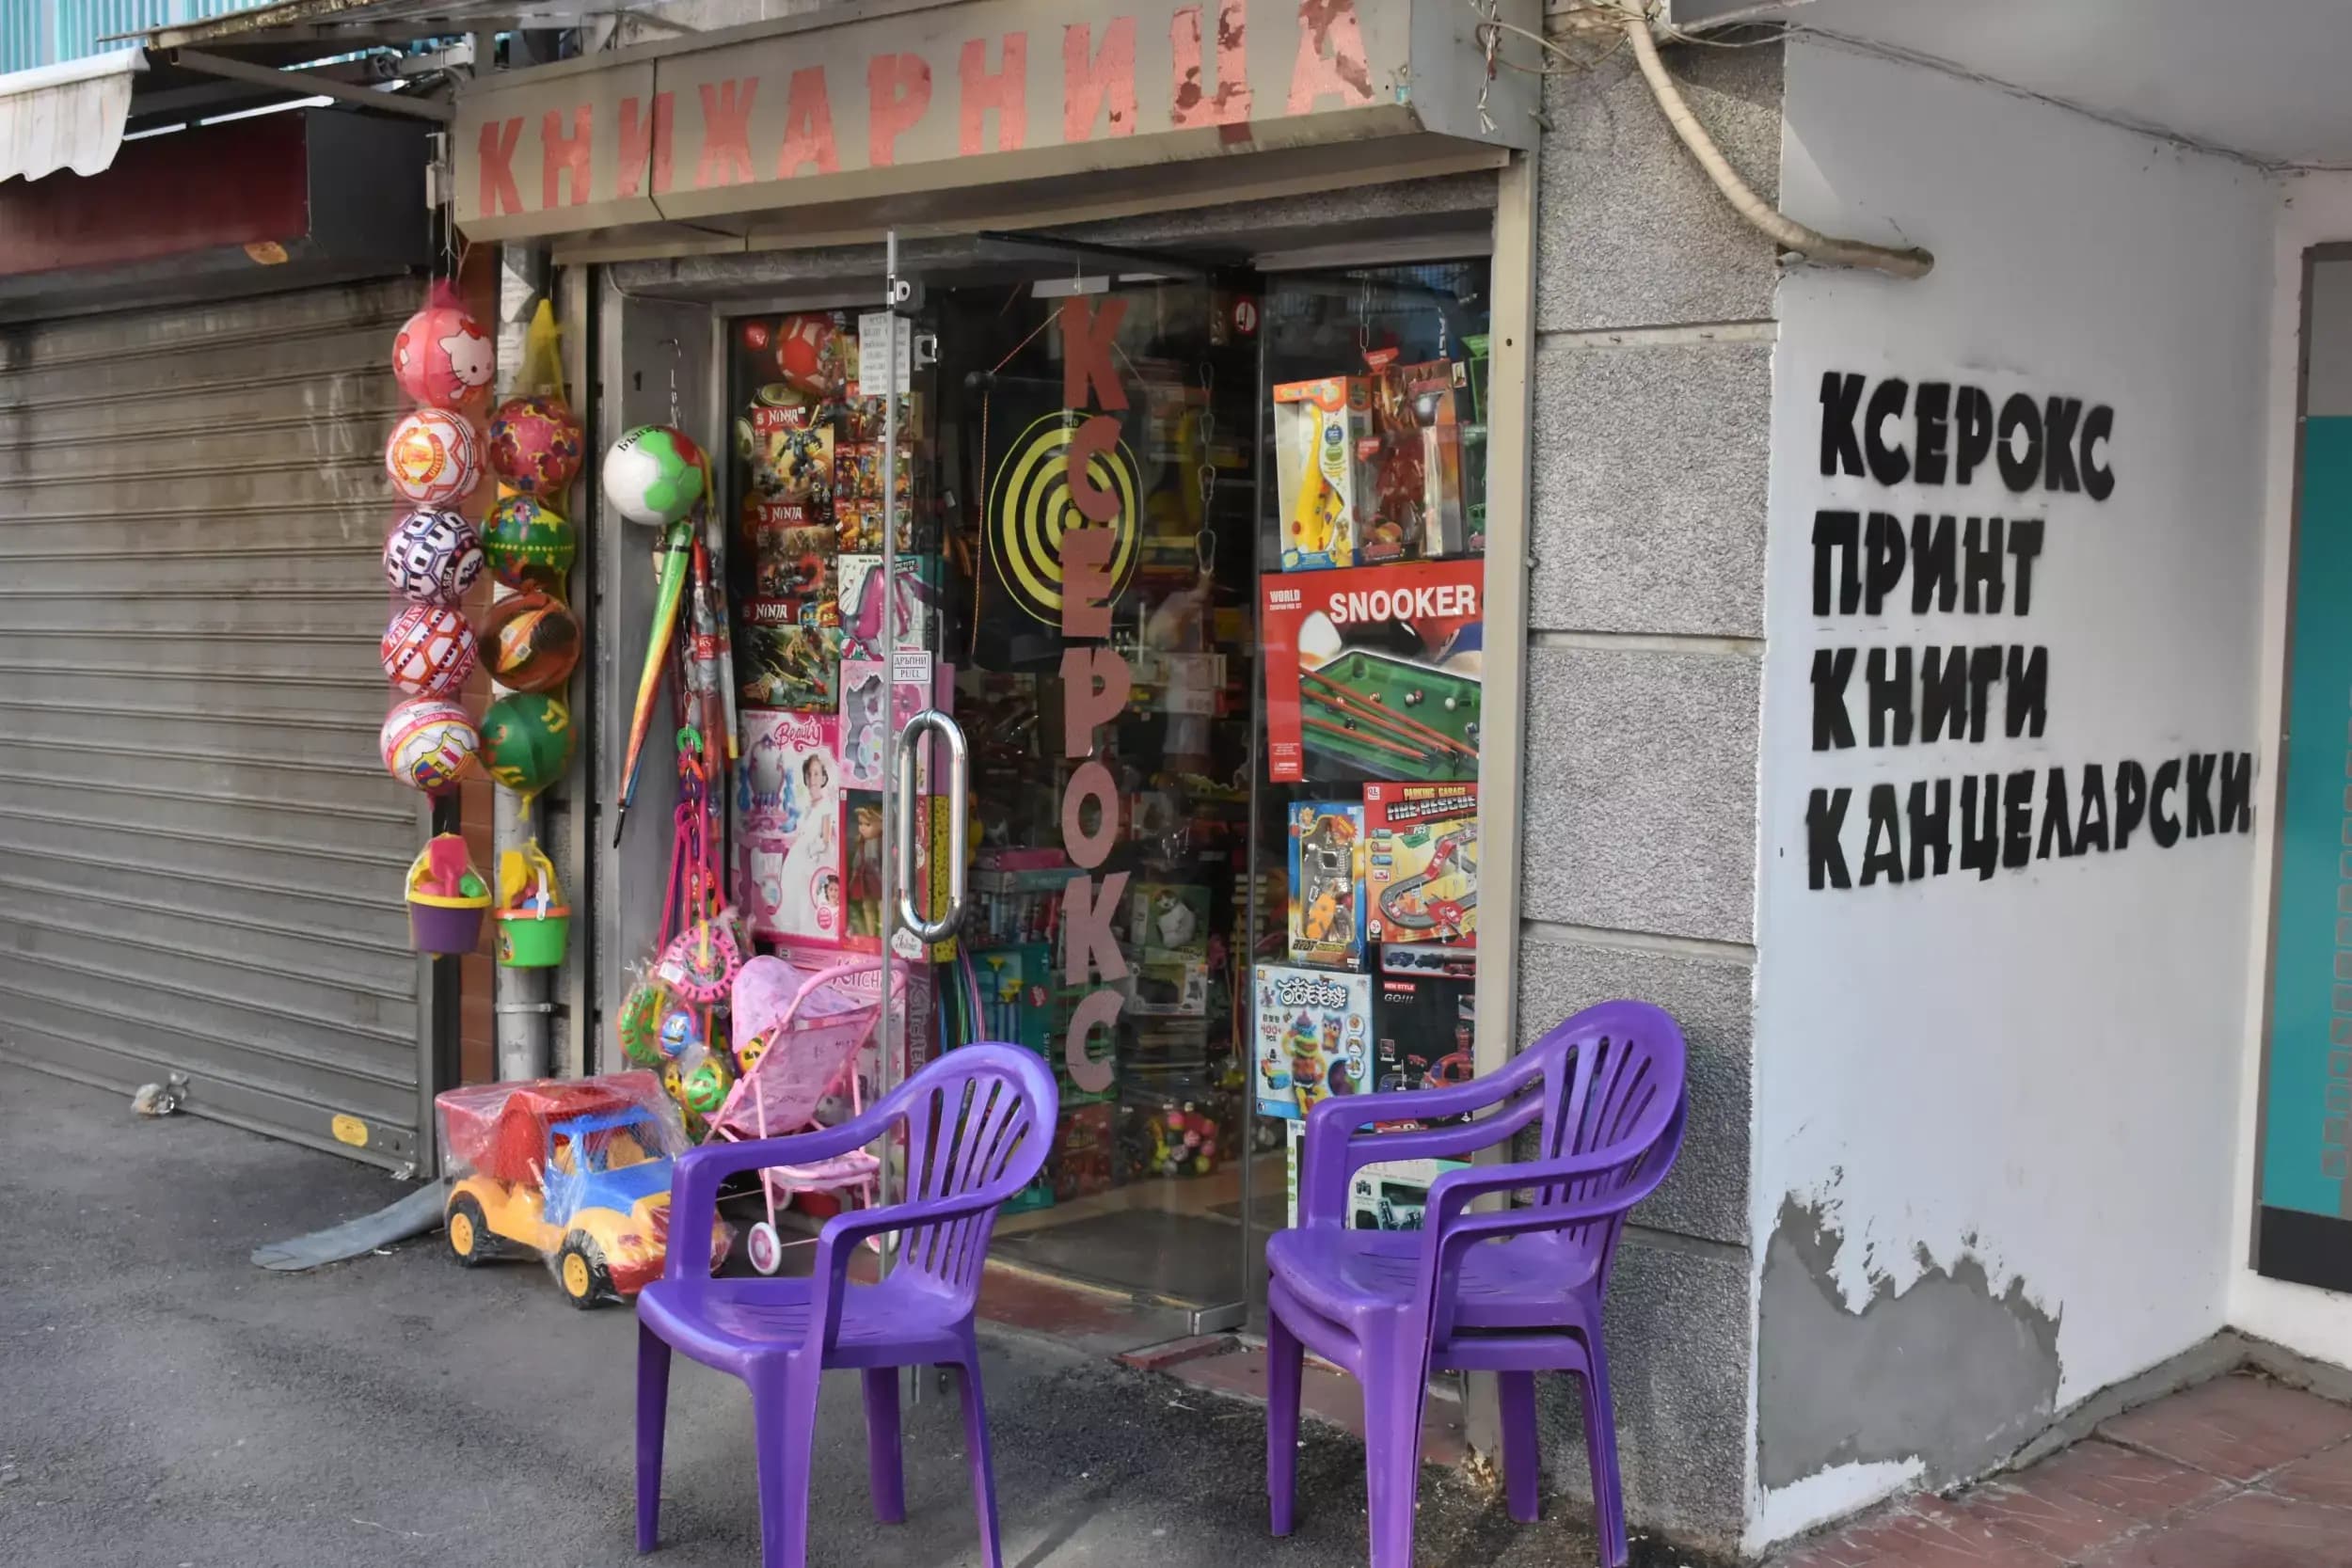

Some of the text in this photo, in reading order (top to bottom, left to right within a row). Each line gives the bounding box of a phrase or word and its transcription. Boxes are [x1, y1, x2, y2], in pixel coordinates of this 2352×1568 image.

[478, 0, 1374, 218] КНИЖАРНИЦА
[1819, 372, 2115, 501] КСЕРОКС
[771, 506, 803, 523] NINJA
[1270, 589, 1301, 602] WORLD
[1811, 510, 2044, 616] ПРИНТ
[754, 603, 787, 621] NINJA
[1329, 585, 1476, 624] SNOOKER
[1058, 296, 1131, 1092] КСЕРОКС
[1810, 644, 2047, 752] КНИГИ
[774, 715, 822, 752] Beauty
[1404, 786, 1466, 800] PARKING GARAGE
[1806, 752, 2251, 890] КАНЦЕЛАРСКИ
